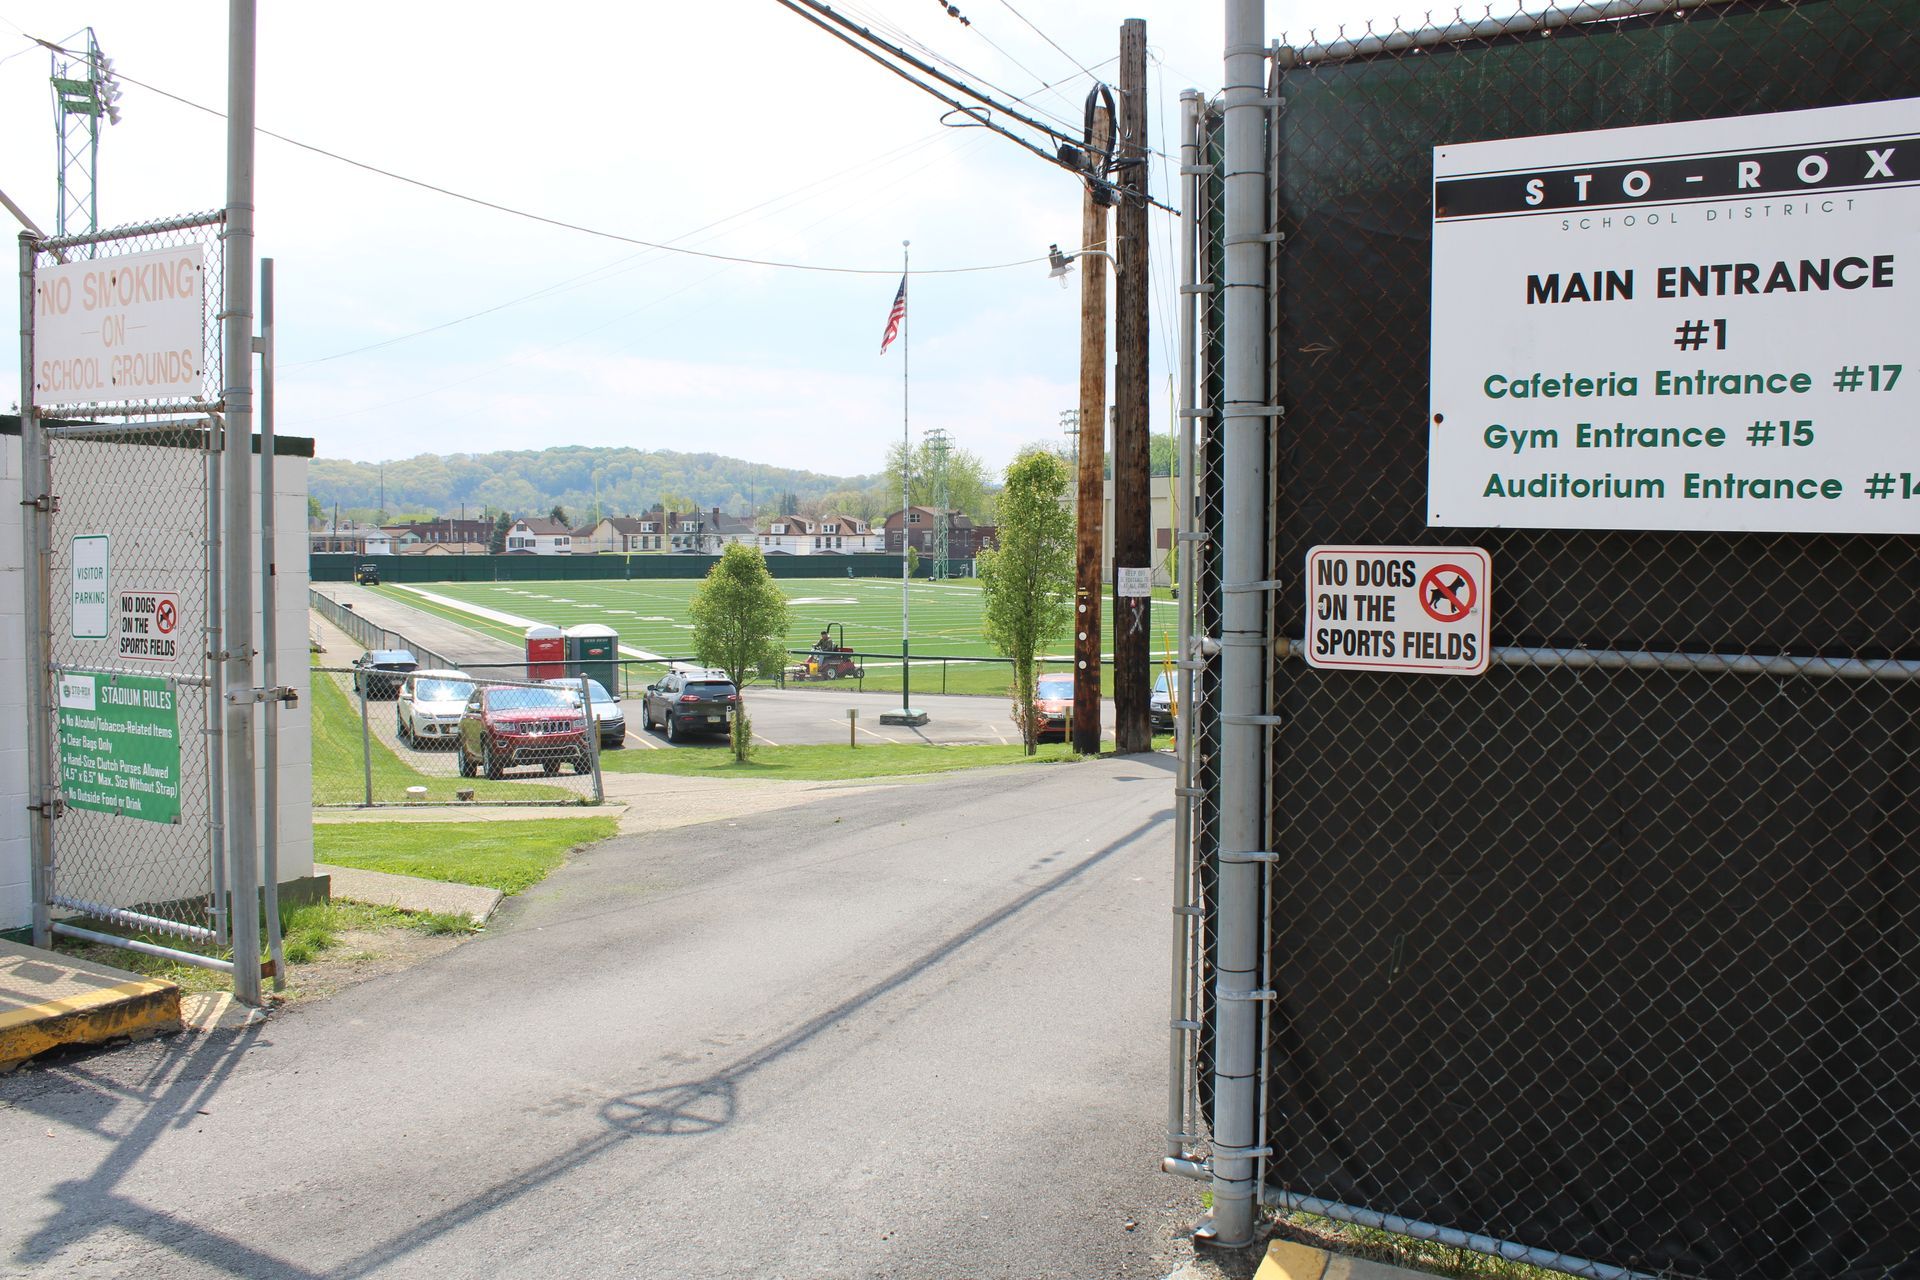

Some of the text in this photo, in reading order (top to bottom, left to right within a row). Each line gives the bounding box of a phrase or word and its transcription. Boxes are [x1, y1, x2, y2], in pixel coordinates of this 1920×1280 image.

[1561, 198, 1855, 231] SCHOOL DISTRICT
[41, 257, 193, 316] NO SMOKING
[1526, 254, 1895, 304] MAIN ENTRANCE
[102, 314, 125, 348] ON
[1673, 318, 1728, 351] #1
[41, 349, 193, 392] SCHOOL GROUNDS
[1483, 364, 1903, 399] Cafeteria Entrance #17
[1483, 419, 1815, 454] Gym Entrance #15
[1482, 472, 1665, 499] Auditorium
[1683, 472, 1843, 500] Entrance
[77, 567, 103, 580] VISITOR
[1317, 559, 1416, 588] NO DOGS
[75, 592, 105, 604] PARKING
[122, 597, 156, 613] NO DOGS
[1317, 593, 1395, 622] ON THE
[122, 617, 148, 633] ON THE
[120, 637, 175, 657] SPORTS FIELDS
[1316, 628, 1477, 661] SPORTS FIELDS
[102, 686, 172, 710] STADIUM RULES
[66, 715, 74, 727] No
[153, 724, 173, 739] Items
[66, 734, 113, 754] Clear Bags Only
[67, 752, 169, 779] Hand-Size Clutch Purses Allowed
[68, 787, 142, 811] No Outside Food or Drink
[98, 773, 114, 787] Max.
[115, 775, 128, 789] Size
[129, 777, 155, 793] Without
[156, 781, 178, 799] Strap)
